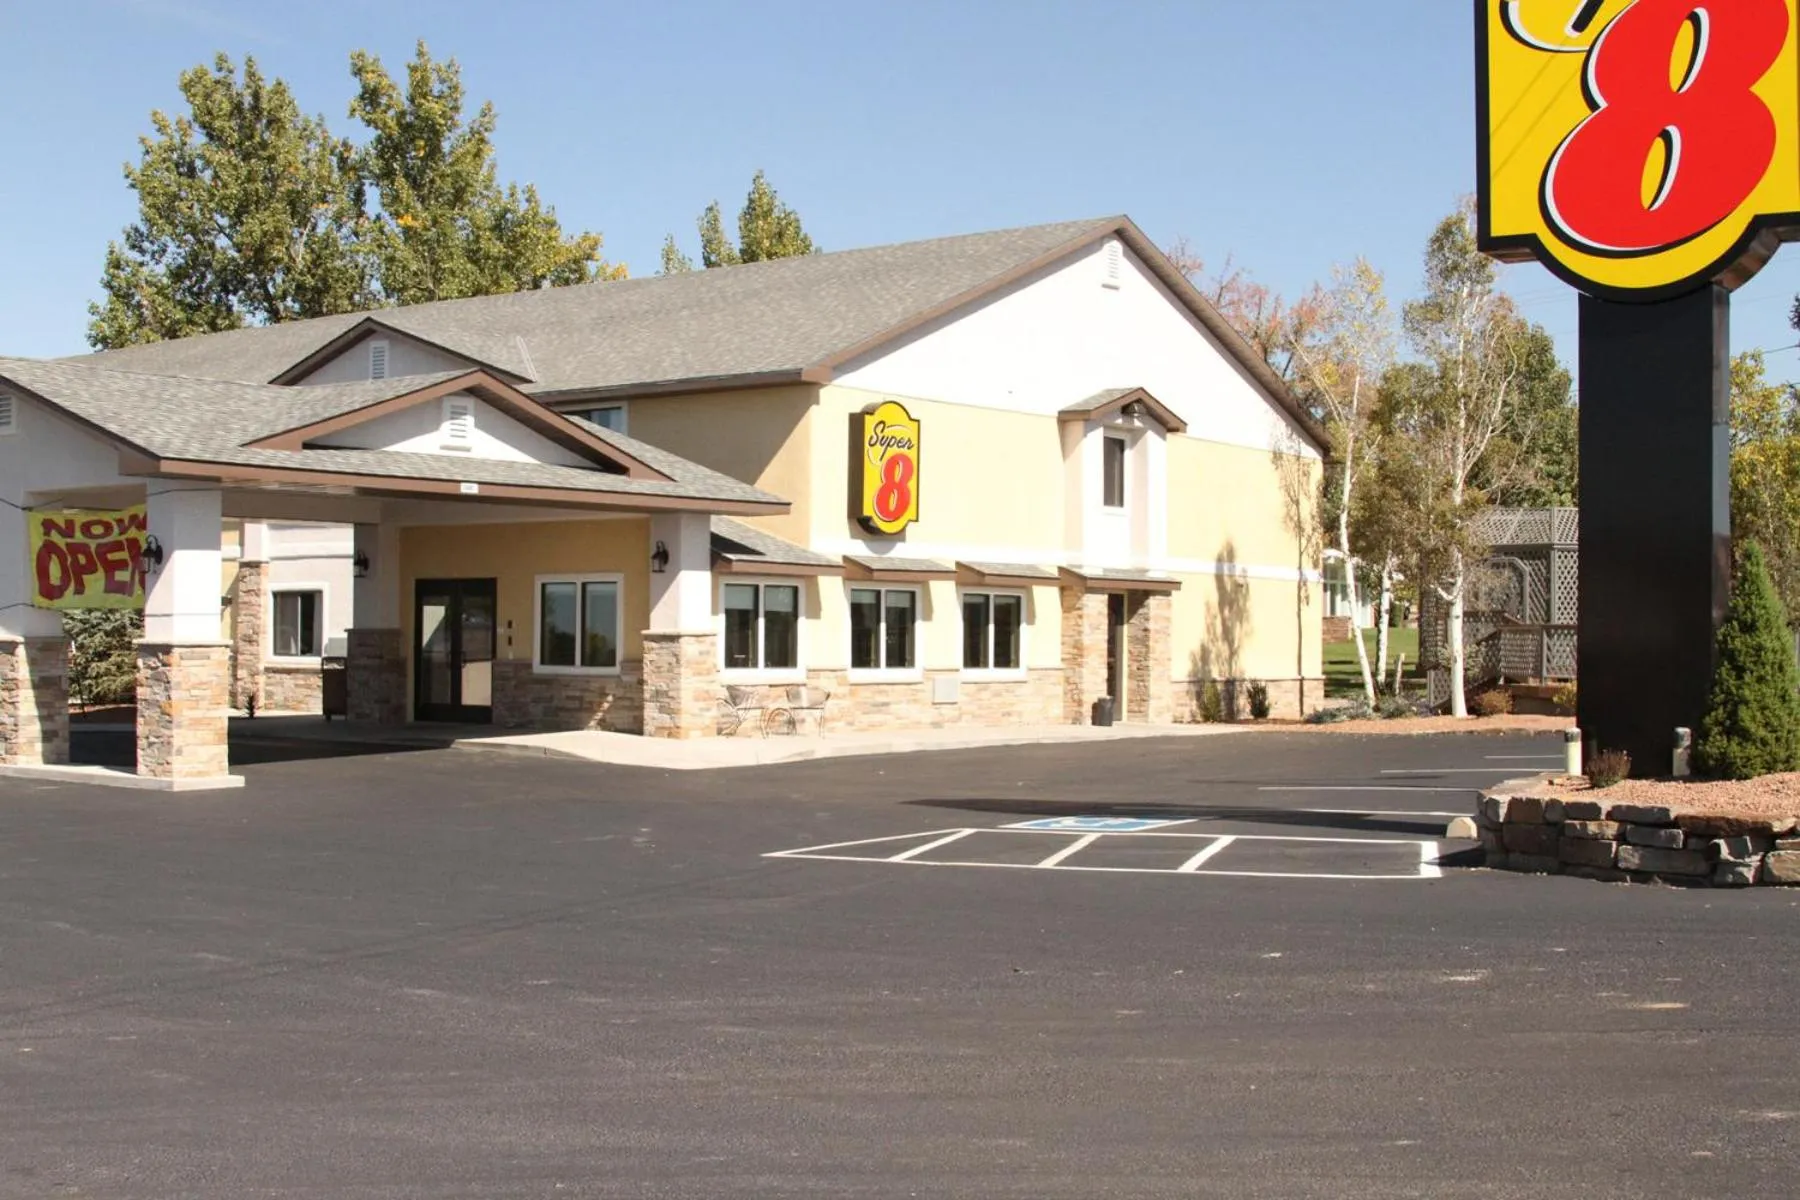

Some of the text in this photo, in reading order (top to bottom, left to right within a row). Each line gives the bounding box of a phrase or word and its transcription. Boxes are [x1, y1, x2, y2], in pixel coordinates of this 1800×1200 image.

[1538, 0, 1790, 259] 8
[868, 420, 914, 462] Super
[873, 453, 914, 522] 8
[41, 512, 147, 540] NOW
